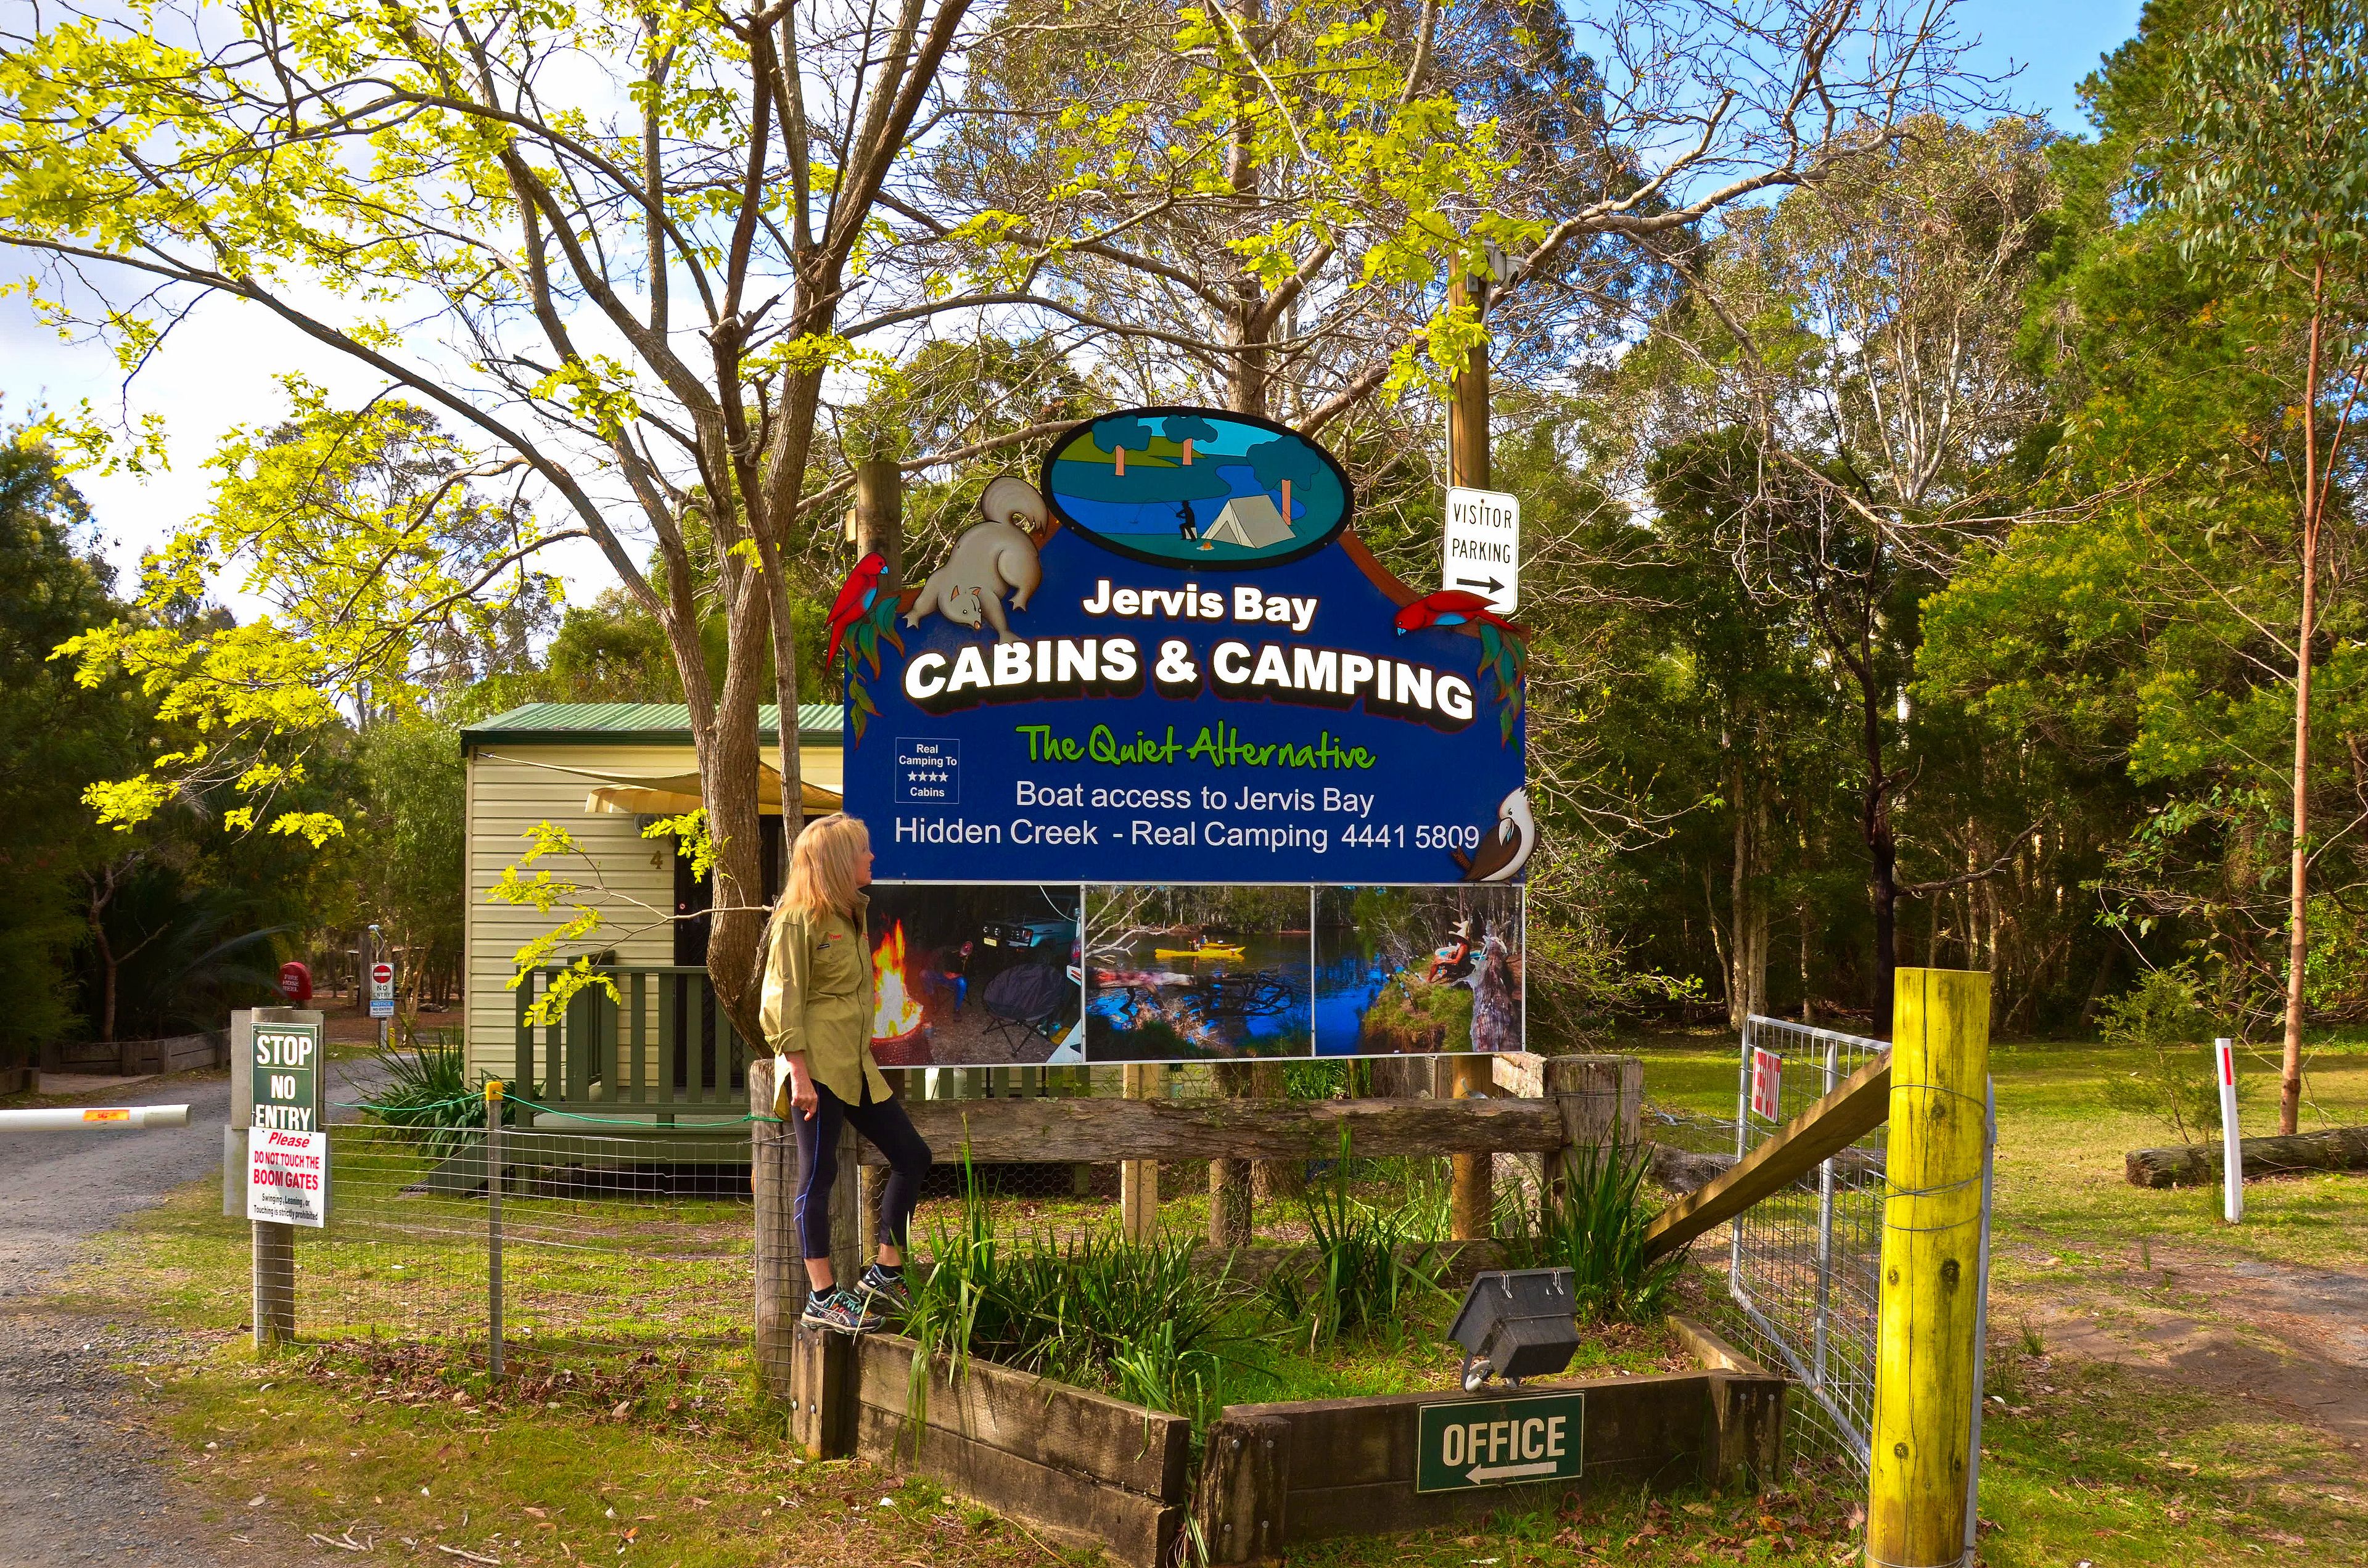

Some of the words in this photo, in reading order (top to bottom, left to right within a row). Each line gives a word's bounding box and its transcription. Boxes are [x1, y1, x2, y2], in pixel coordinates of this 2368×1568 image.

[1453, 503, 1511, 528] VISITOR
[1452, 538, 1510, 564] PARKING
[1083, 580, 1223, 617] Jervis
[1235, 587, 1317, 631] Bay
[906, 639, 1137, 698] CABINS
[1156, 641, 1197, 682] &
[1214, 642, 1472, 719] CAMPING
[917, 744, 937, 753] Real
[1016, 725, 1085, 760] The
[1089, 724, 1182, 765] Quiet
[1186, 721, 1376, 768] Alternative
[899, 755, 942, 767] Camping
[942, 757, 957, 766] To
[910, 787, 944, 797] Cabins
[1017, 781, 1083, 807] Boat
[1092, 789, 1191, 808] access
[1201, 786, 1227, 810] to
[1235, 787, 1315, 811] Jervis
[1324, 788, 1374, 818] Bay
[896, 818, 1000, 843] Hidden
[1011, 819, 1098, 844] Creek
[1133, 821, 1194, 845] Real
[1205, 822, 1327, 853] Camping
[1342, 824, 1403, 847] 4441
[1416, 826, 1479, 848] 5809
[650, 850, 663, 869] 4
[257, 1035, 313, 1066] STOP
[271, 1075, 296, 1100] NO
[255, 1104, 312, 1131] ENTRY
[268, 1131, 310, 1147] Please
[255, 1151, 264, 1164] DO
[265, 1151, 279, 1165] NOT
[281, 1153, 305, 1168] TOUCH
[306, 1155, 319, 1169] THE
[253, 1168, 283, 1186] BOOM
[286, 1172, 318, 1190] GATES
[253, 1204, 273, 1217] Touching
[274, 1207, 278, 1216] is
[279, 1209, 295, 1219] strictly
[295, 1210, 318, 1220] prohibited
[1443, 1416, 1566, 1466] OFFICE
